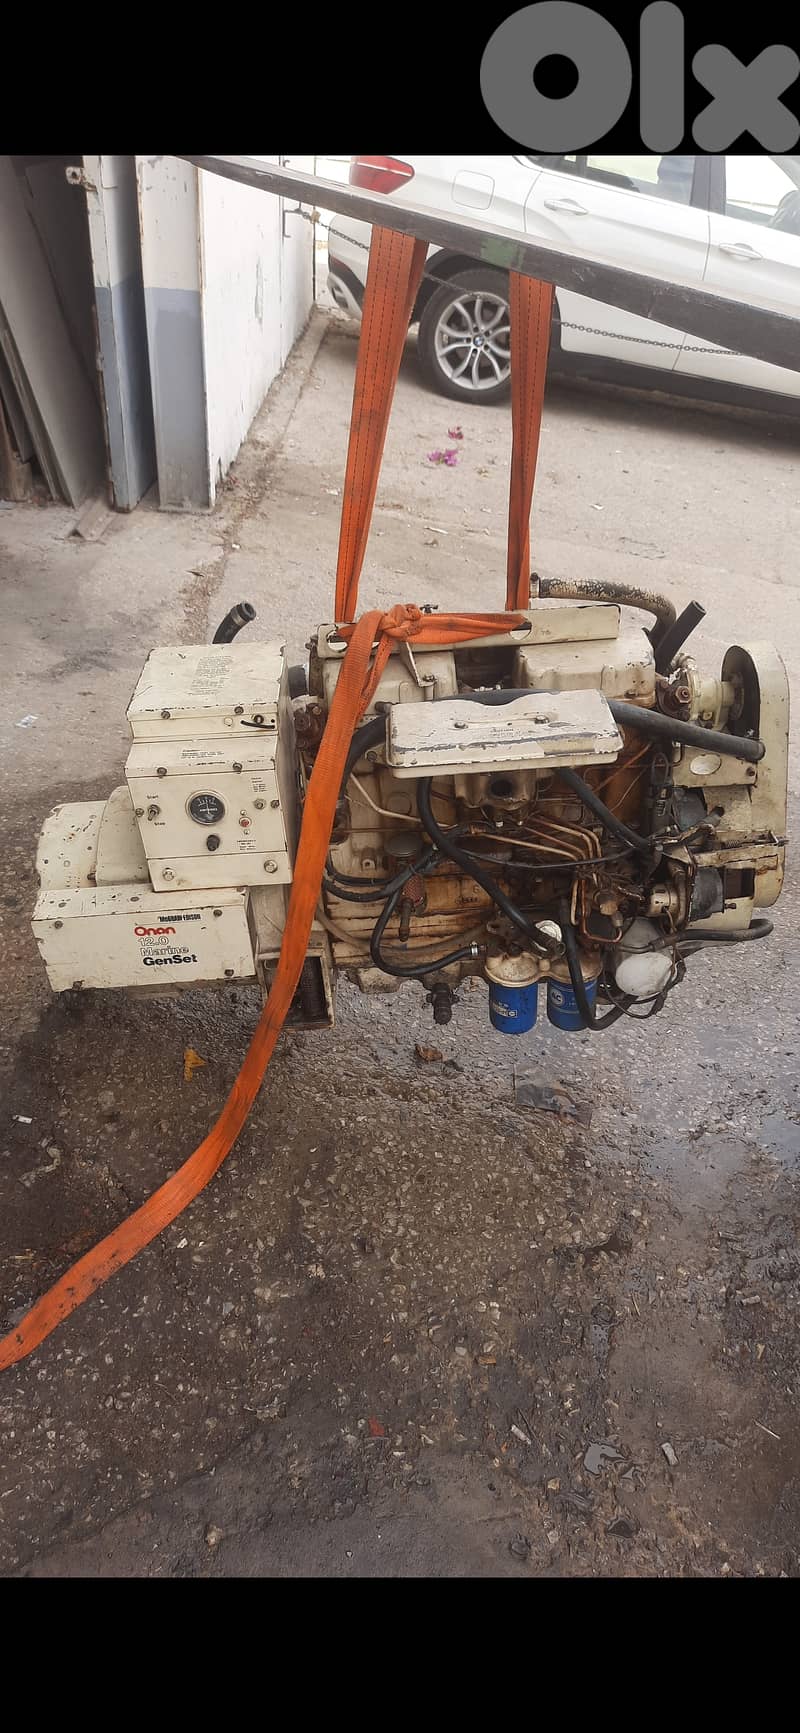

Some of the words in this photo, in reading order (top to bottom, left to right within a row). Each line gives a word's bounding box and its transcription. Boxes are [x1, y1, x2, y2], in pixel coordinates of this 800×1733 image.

[134, 926, 176, 936] Onan
[138, 936, 169, 946] 12.0
[140, 946, 190, 956] Marine
[143, 954, 198, 966] GenSet
